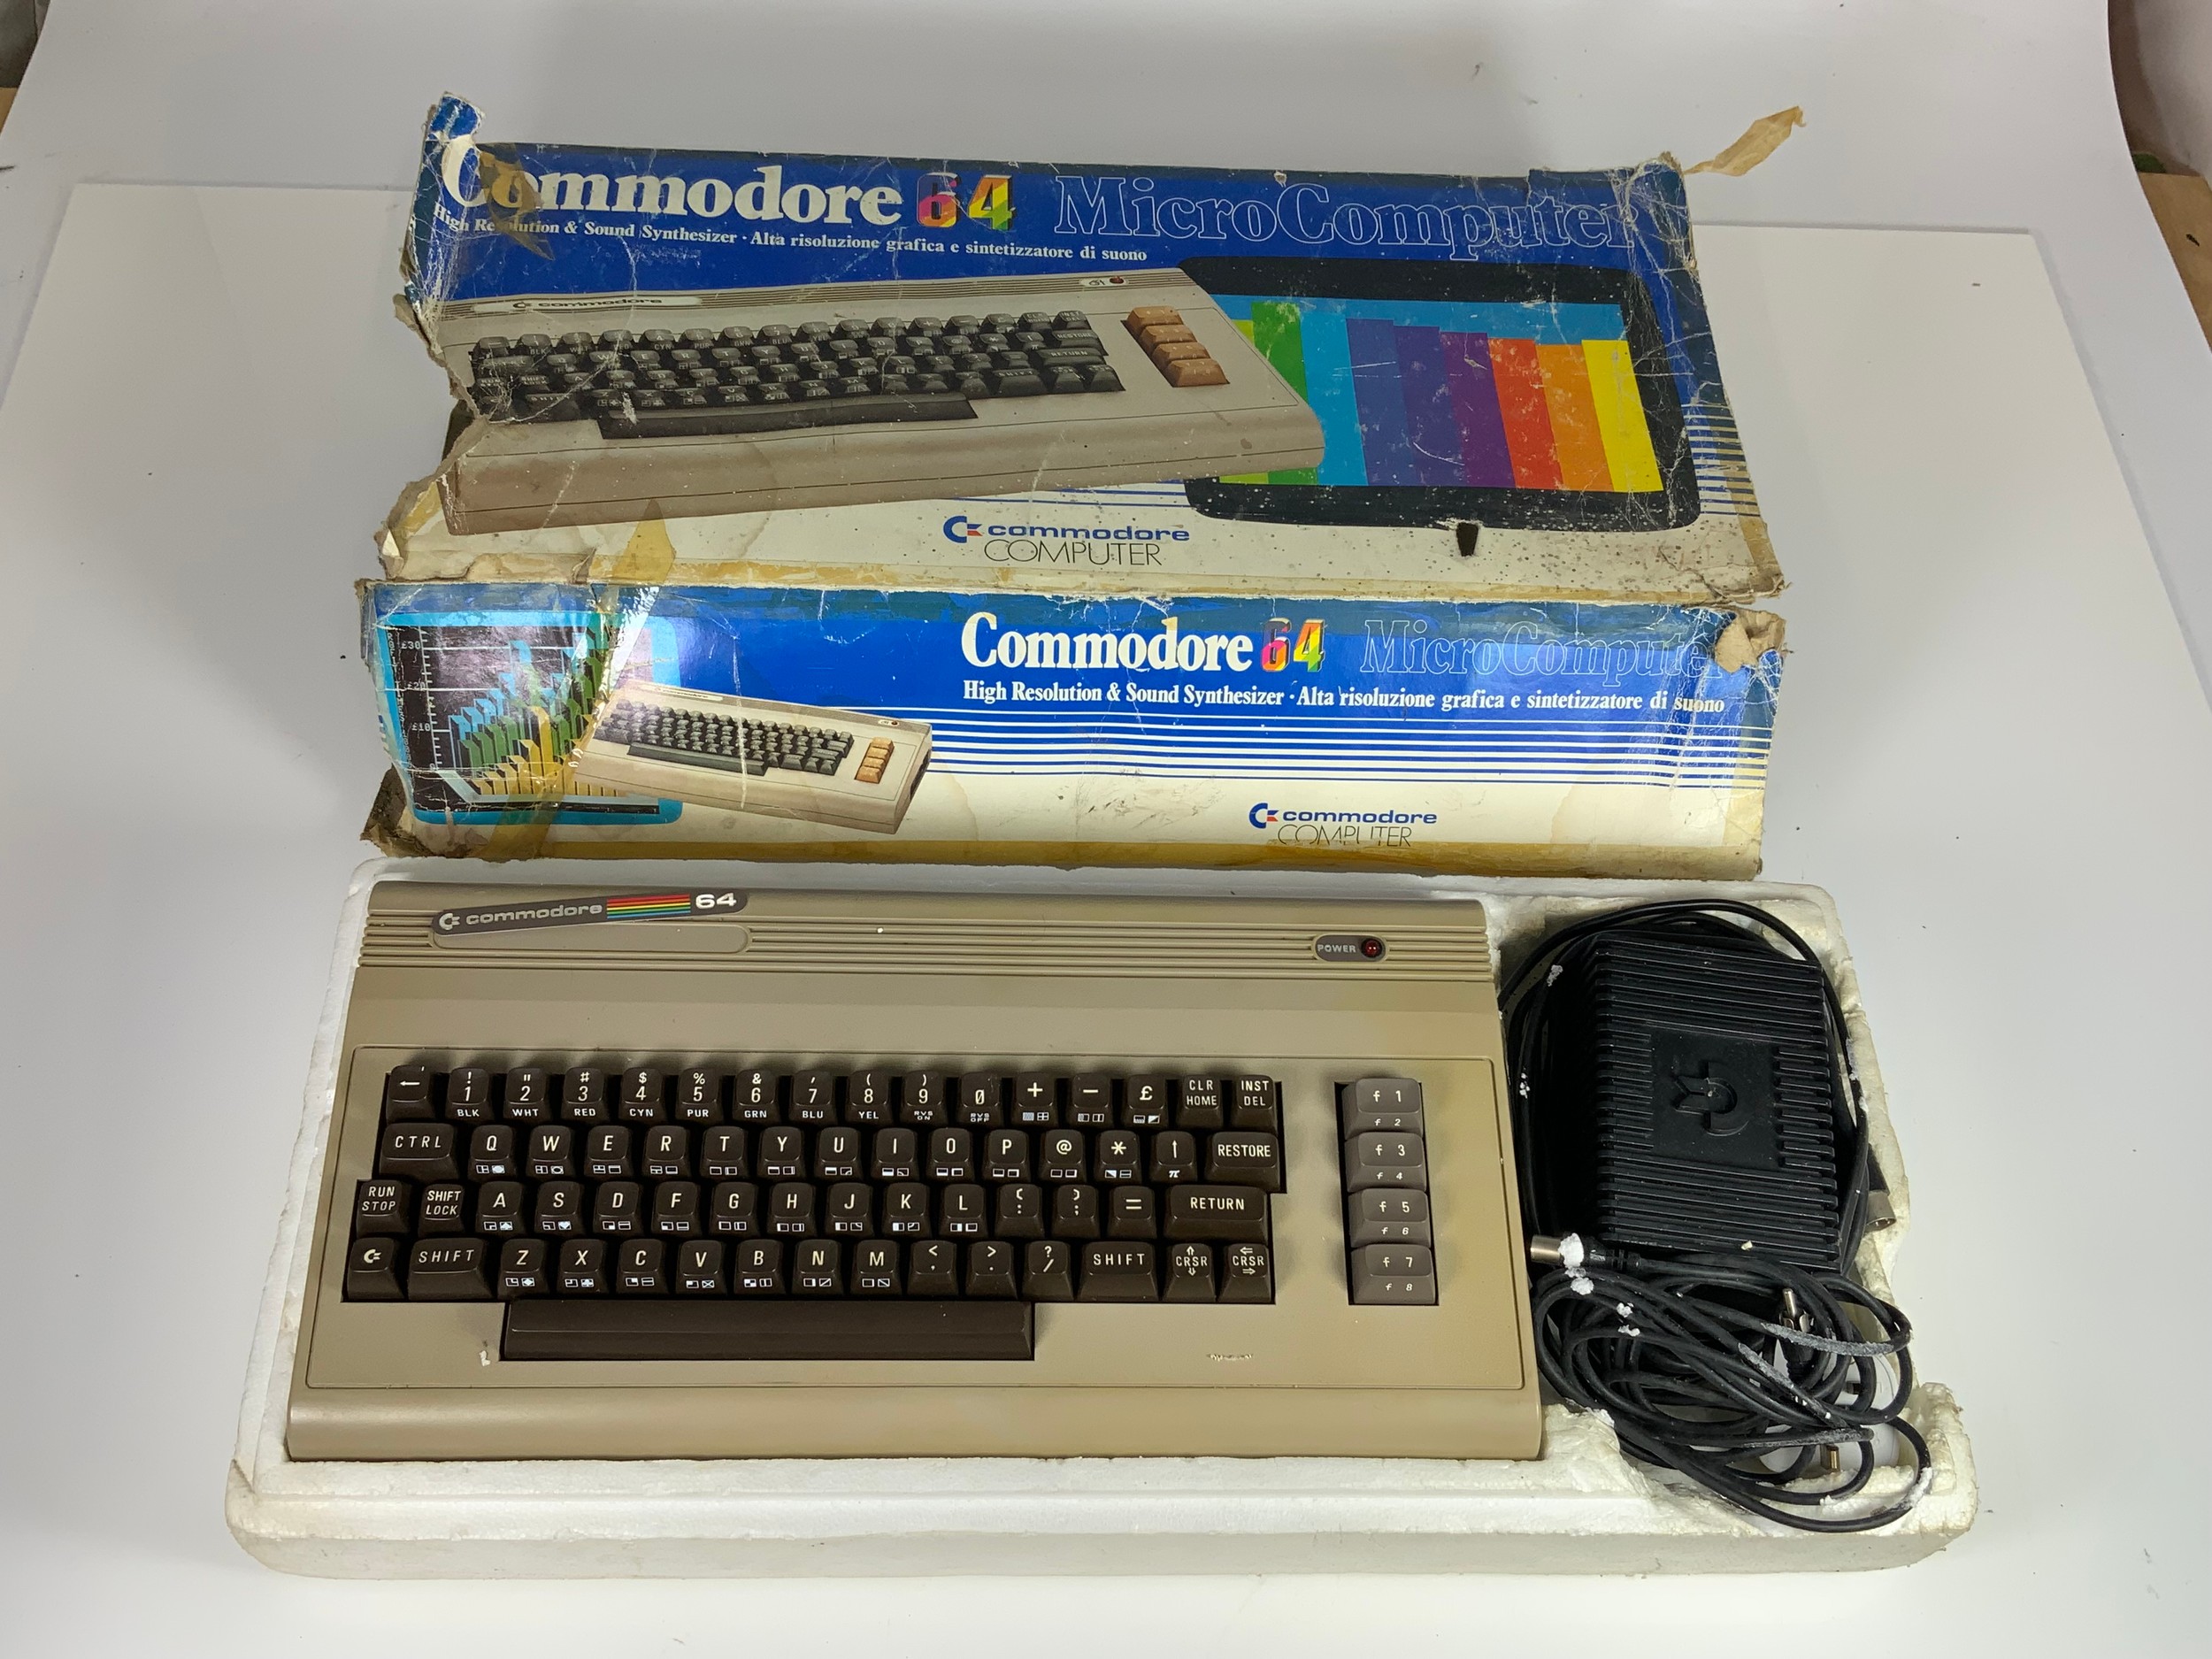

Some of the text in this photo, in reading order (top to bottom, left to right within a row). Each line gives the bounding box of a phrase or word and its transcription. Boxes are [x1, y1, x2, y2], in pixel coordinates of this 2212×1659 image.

[442, 134, 1638, 262] Commodore 64 MicroComputer
[434, 201, 470, 232] High
[564, 221, 578, 234] &
[584, 221, 634, 238] Sound
[641, 224, 736, 245] Synthesizer
[750, 231, 786, 247] Alta
[790, 234, 880, 250] risoluzione
[886, 238, 946, 255] grafica
[950, 243, 960, 253] e
[965, 242, 1072, 258] sintetizzatore
[1079, 245, 1096, 259] di
[1102, 249, 1148, 262] suono
[987, 525, 1190, 541] commodore
[984, 538, 1163, 566] COMPUTER
[401, 641, 421, 649] £30
[961, 611, 1254, 672] Commodore
[1262, 618, 1325, 672] 64
[963, 680, 1725, 713] High Resolution & Sound Synthesizer Alta risoluzione grafica e sintetizzatore di suono
[1283, 810, 1438, 825] commodore
[465, 892, 738, 926] commodore 64
[1317, 944, 1356, 954] POWER
[638, 1071, 648, 1084] $
[693, 1072, 706, 1085] %
[751, 1072, 762, 1085] &
[866, 1073, 872, 1087] (
[922, 1073, 927, 1087] )
[1188, 1079, 1214, 1091] CLR
[1240, 1079, 1270, 1092] INST
[465, 1086, 472, 1102] 1
[519, 1085, 531, 1102] 2
[578, 1085, 588, 1102] 3
[635, 1086, 647, 1101] 4
[693, 1086, 703, 1102] 5
[750, 1087, 761, 1103] 6
[808, 1088, 818, 1103] 7
[864, 1087, 873, 1103] 8
[918, 1088, 928, 1104] 9
[1026, 1081, 1043, 1098] +
[1139, 1085, 1153, 1101] £
[1186, 1094, 1217, 1106] HOME
[1243, 1095, 1266, 1106] DEL
[457, 1109, 480, 1118] BLK
[511, 1108, 539, 1117] WHT
[573, 1108, 596, 1117] RED
[629, 1108, 654, 1118] CYN
[687, 1109, 709, 1118] PUR
[744, 1110, 767, 1118] GRN
[802, 1110, 824, 1119] BLU
[858, 1110, 879, 1119] YEL
[917, 1111, 933, 1121] ON
[970, 1112, 990, 1121] RVS
[970, 1113, 990, 1123] OFF
[395, 1135, 442, 1148] CTRL
[486, 1135, 497, 1151] Q
[542, 1135, 560, 1152] W
[603, 1134, 614, 1151] E
[660, 1135, 672, 1152] R
[719, 1135, 730, 1152] T
[777, 1136, 788, 1152] Y
[833, 1136, 844, 1153] U
[893, 1138, 897, 1155] I
[1002, 1139, 1012, 1156] P
[1056, 1139, 1072, 1156] @
[1217, 1144, 1271, 1157] RESTORE
[368, 1186, 396, 1198] RUN
[426, 1190, 462, 1202] SHIFT
[492, 1192, 506, 1208] A
[553, 1192, 565, 1208] S
[361, 1201, 396, 1211] STOP
[611, 1192, 624, 1209] D
[671, 1192, 682, 1209] F
[728, 1193, 740, 1210] G
[787, 1194, 797, 1210] H
[843, 1194, 855, 1210] J
[901, 1194, 912, 1210] K
[958, 1194, 968, 1210] L
[1125, 1199, 1142, 1210] =
[1190, 1196, 1245, 1210] RETURN
[426, 1204, 458, 1216] LOCK
[419, 1249, 475, 1263] SHIFT
[516, 1249, 529, 1265] Z
[574, 1249, 588, 1266] X
[635, 1249, 647, 1266] C
[695, 1251, 708, 1268] V
[753, 1250, 764, 1266] B
[811, 1250, 825, 1266] N
[869, 1251, 885, 1266] M
[1044, 1245, 1052, 1258] ?
[1093, 1253, 1145, 1266] SHIFT
[1175, 1251, 1208, 1267] CRSR
[1232, 1250, 1264, 1267] CRSR
